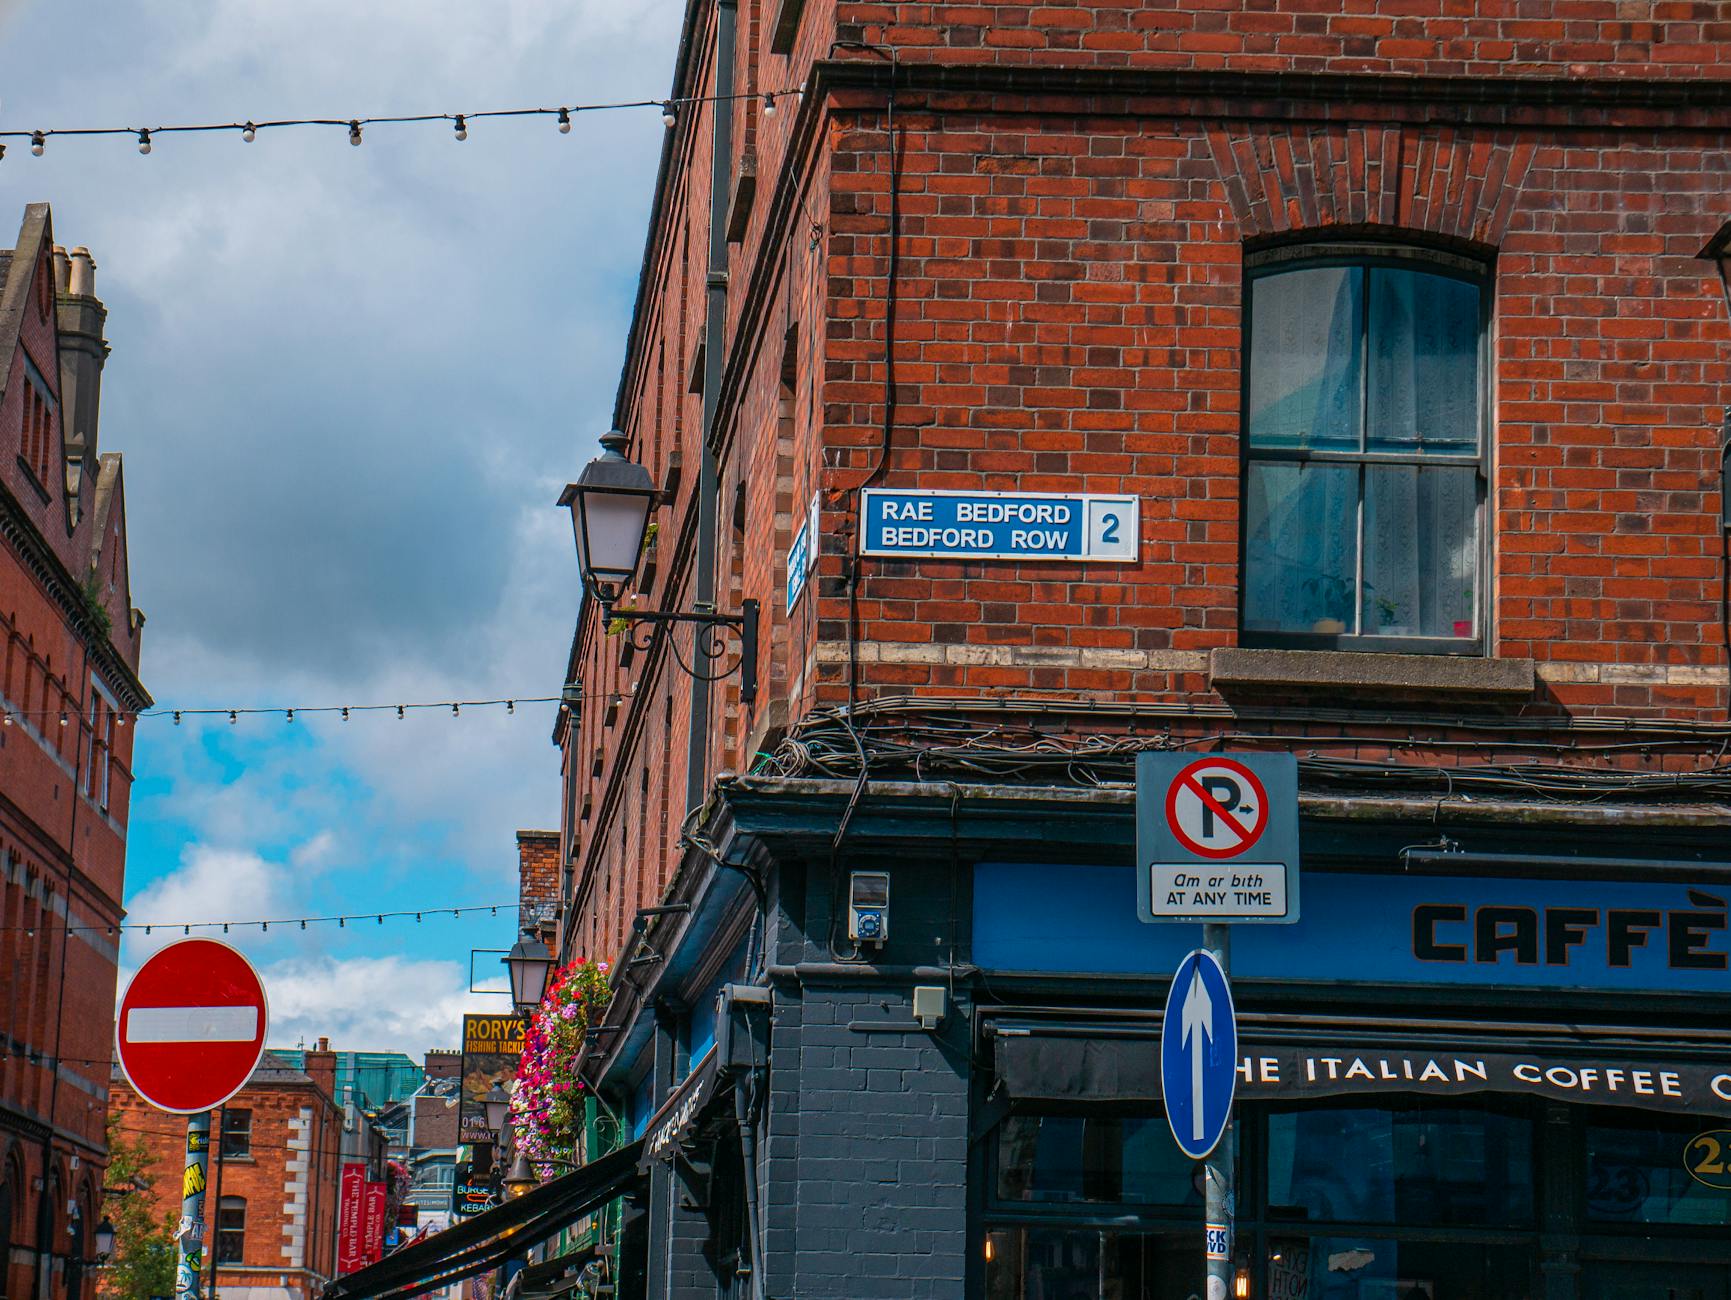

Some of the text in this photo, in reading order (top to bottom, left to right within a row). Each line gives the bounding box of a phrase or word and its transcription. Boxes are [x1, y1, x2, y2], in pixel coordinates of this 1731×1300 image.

[881, 501, 1120, 544] RAE BEDFORD 2
[881, 528, 1069, 550] BEDFORD ROW
[1208, 875, 1225, 888] ar
[1166, 892, 1272, 905] AT ANY TIME
[1411, 887, 1729, 971] CAFFÈ
[466, 1019, 526, 1040] RORY'S
[465, 1040, 497, 1054] FISHING
[1306, 1056, 1488, 1082] ITALIAN
[1512, 1063, 1682, 1097] COFFEE
[1693, 1137, 1731, 1175] 2
